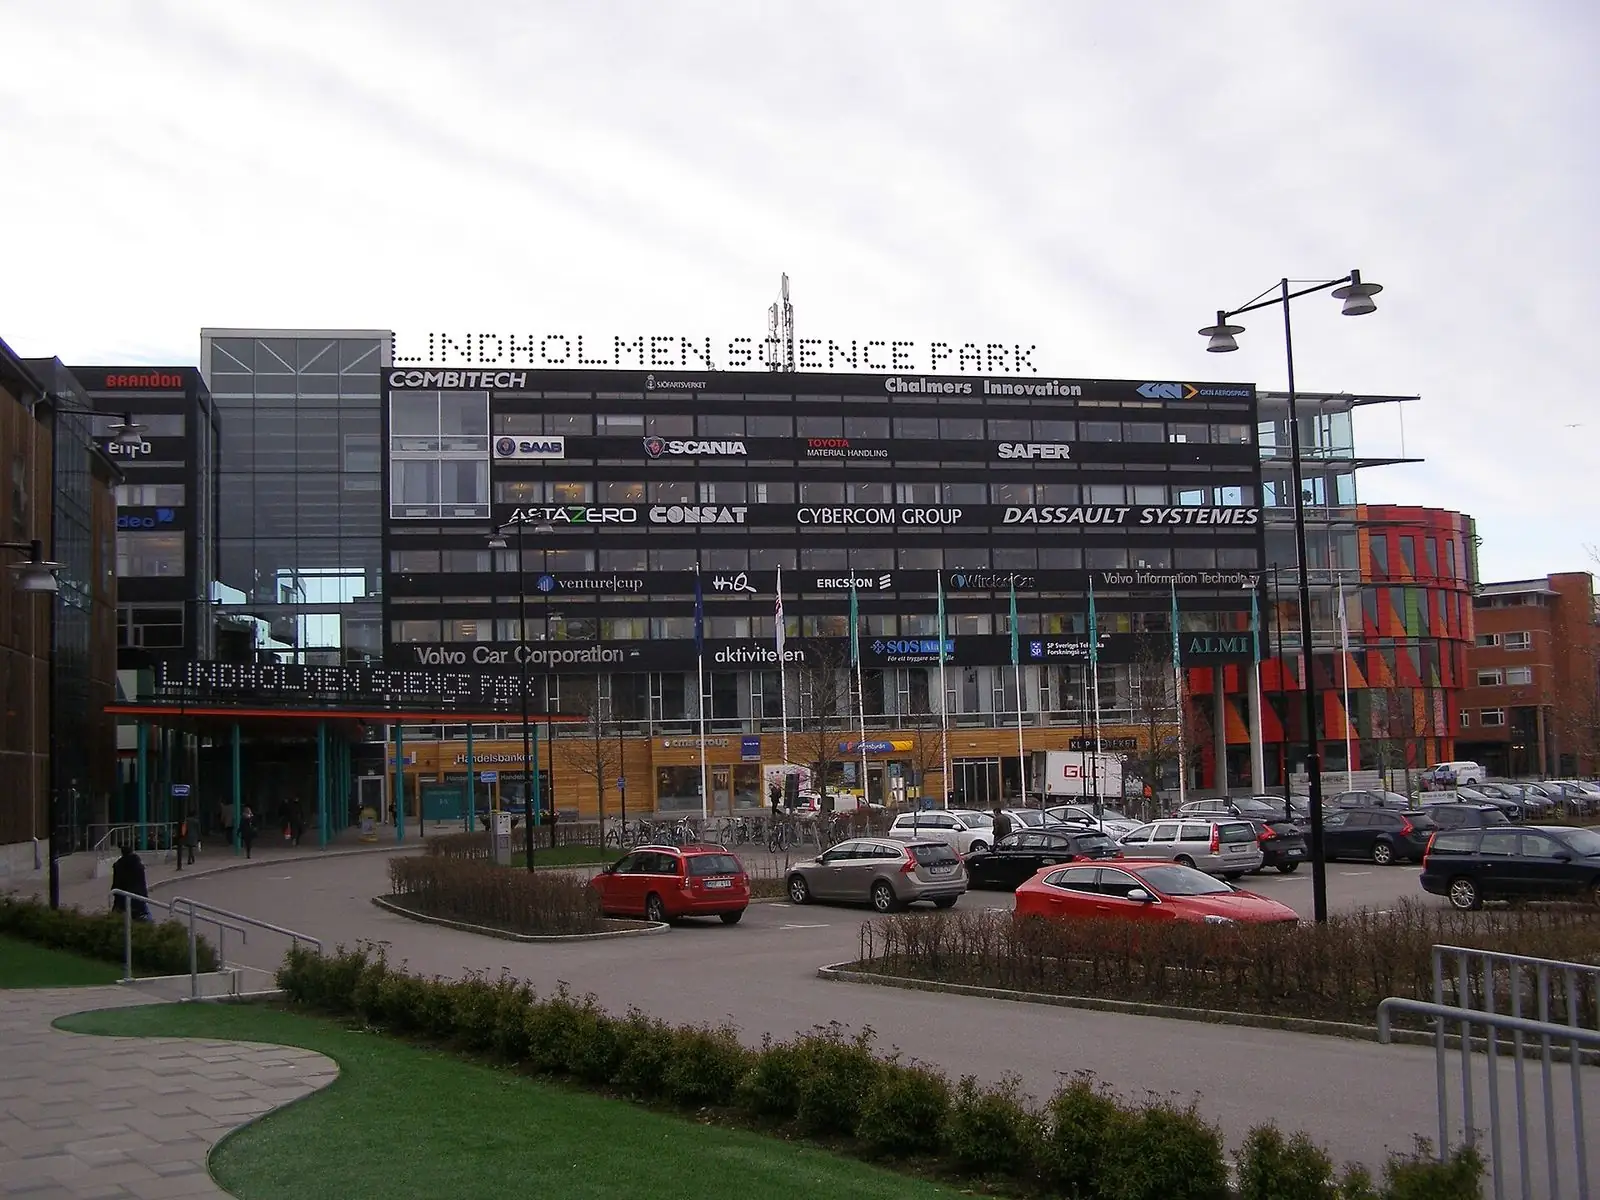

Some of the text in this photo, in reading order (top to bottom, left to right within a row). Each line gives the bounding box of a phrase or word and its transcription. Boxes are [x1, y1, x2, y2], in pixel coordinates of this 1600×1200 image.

[391, 332, 1038, 372] LINDHOLMEN SCIENCE PARK
[389, 371, 528, 388] COMBITECH
[885, 377, 1082, 397] Chalmers Innovation
[519, 442, 562, 453] SAAB
[668, 440, 748, 456] SCANIA
[807, 439, 849, 447] TOYOTA
[998, 443, 1070, 460] SAFER
[807, 449, 888, 458] MATERIAL HANDLING
[649, 505, 748, 524] CONSAT
[797, 508, 963, 525] CYBERCOM GROUP
[1003, 507, 1259, 526] DASSAULT SYSTEMES
[1103, 572, 1133, 584] Volvo
[1137, 572, 1198, 584] Information
[715, 646, 805, 662] aktiviteen
[886, 640, 920, 654] SOS
[1189, 638, 1248, 653] ALMI
[415, 645, 624, 668] Volvo Car Corporation
[162, 660, 361, 692] LINDHOLMEN
[371, 670, 471, 695] SCIENCE
